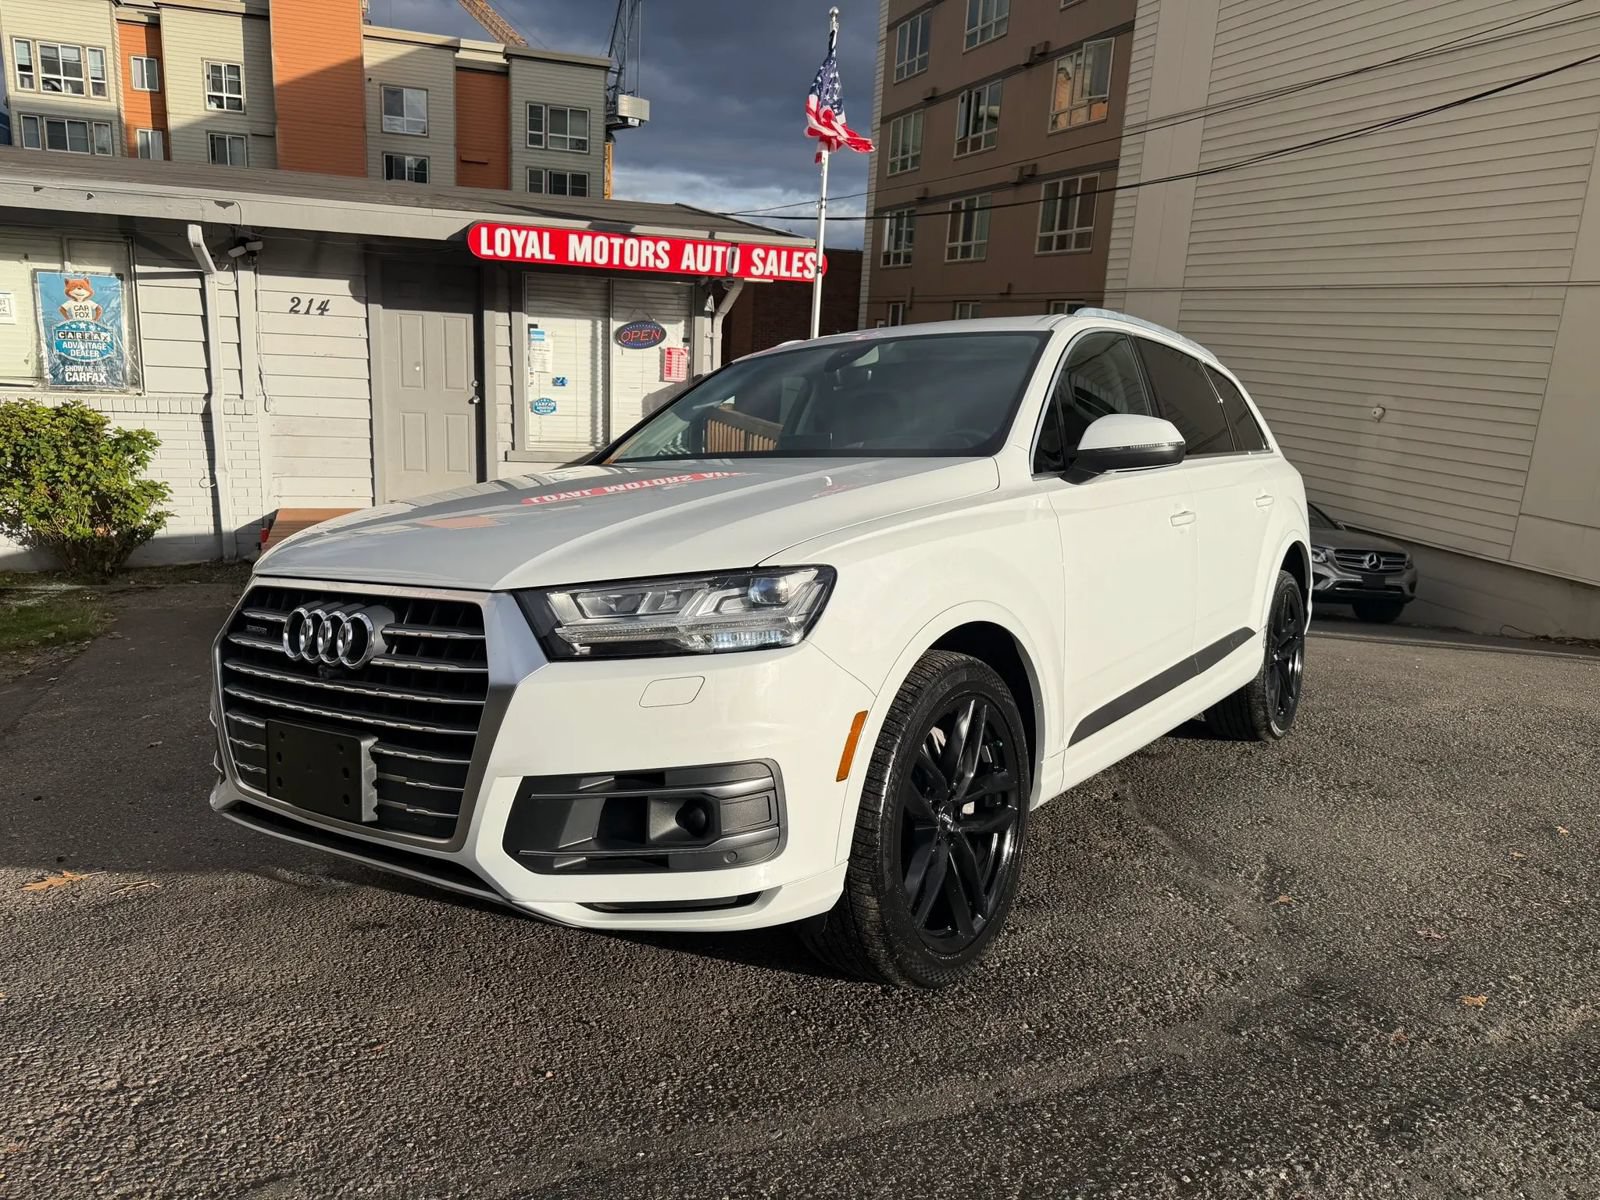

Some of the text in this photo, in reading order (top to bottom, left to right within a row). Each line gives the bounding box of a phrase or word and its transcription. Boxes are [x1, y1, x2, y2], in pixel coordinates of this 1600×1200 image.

[480, 227, 817, 279] LOYAL MOTORS AUTO SALES
[289, 296, 330, 316] 214
[57, 331, 111, 342] CARFAX
[621, 329, 661, 342] OPEN
[62, 342, 107, 350] ADVANTAGE
[70, 349, 100, 357] DEALER
[65, 372, 107, 382] CARFAX
